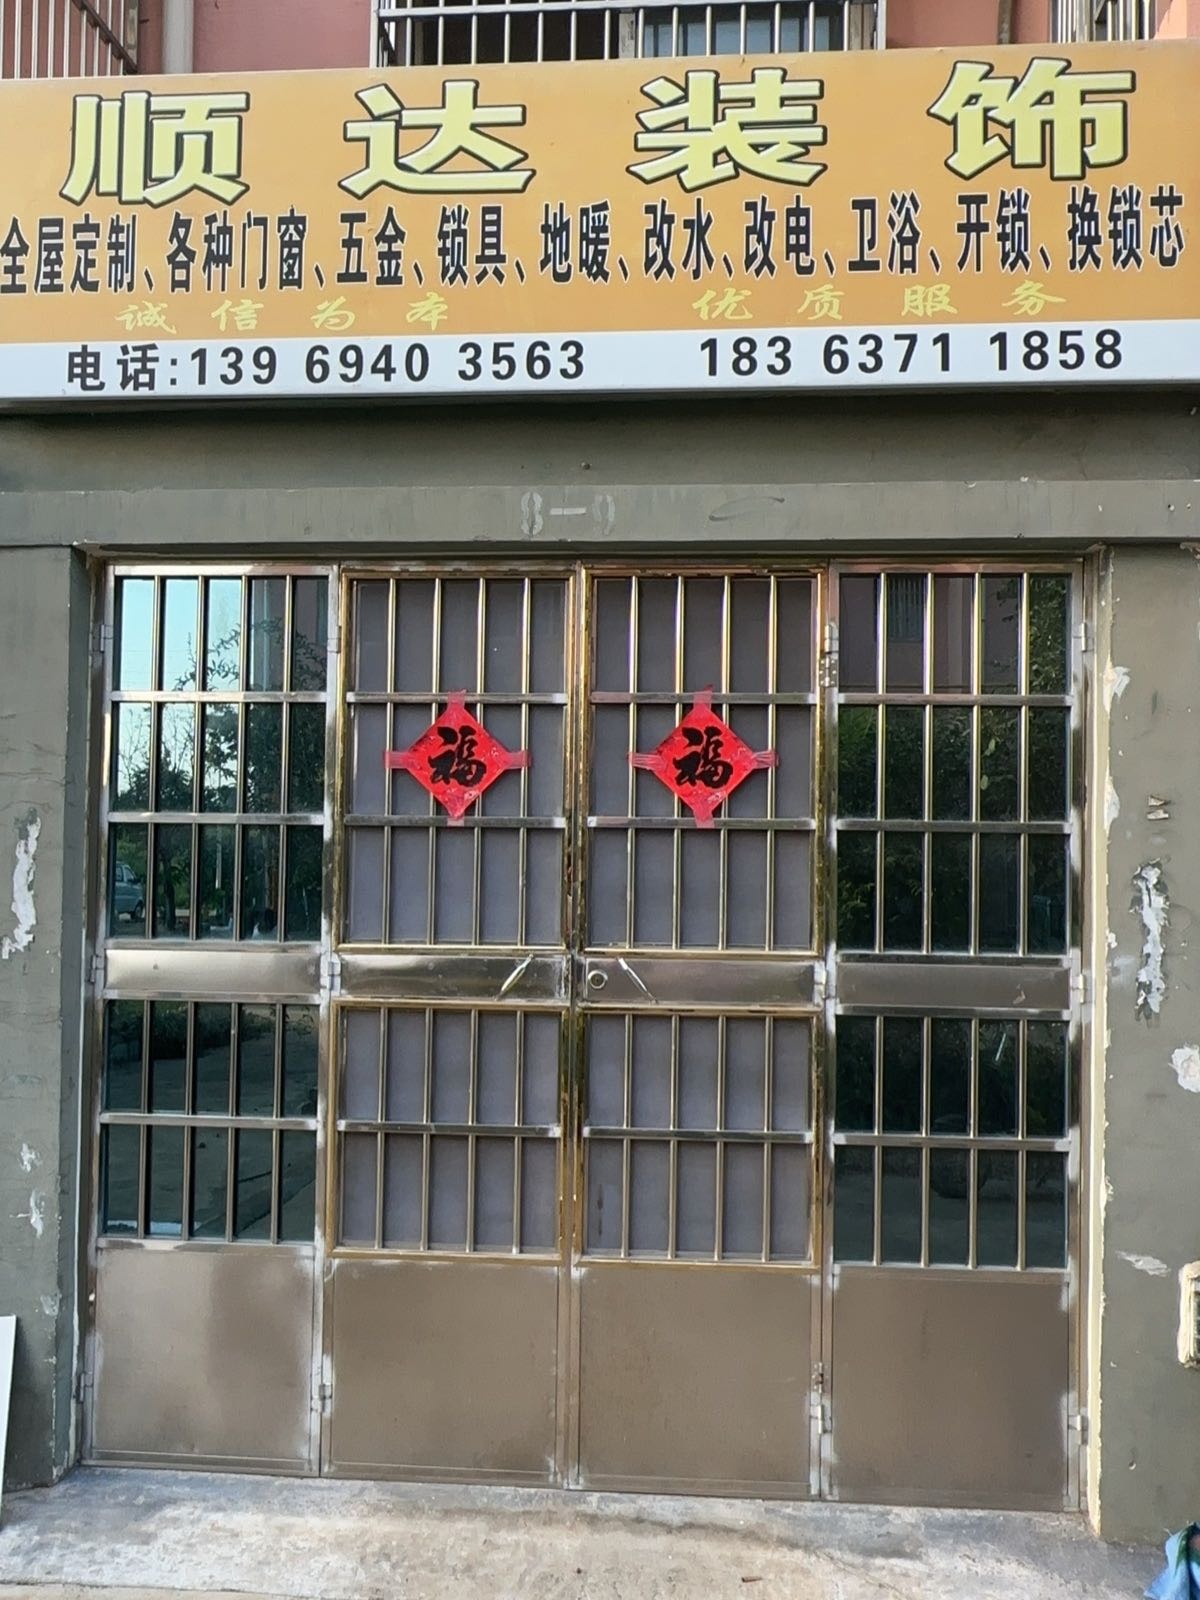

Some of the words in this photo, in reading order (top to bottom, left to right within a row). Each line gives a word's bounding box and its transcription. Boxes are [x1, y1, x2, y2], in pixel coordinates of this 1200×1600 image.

[59, 57, 1136, 208] 顺达装饰
[115, 291, 449, 335] 诚信为本
[692, 280, 1067, 322] 优质服务
[305, 343, 430, 383] 6940
[457, 341, 585, 381] 3563
[700, 336, 792, 377] 183
[822, 333, 951, 374] 6371
[989, 329, 1123, 371] 1858
[428, 725, 488, 789] 福
[672, 726, 733, 790] 福
